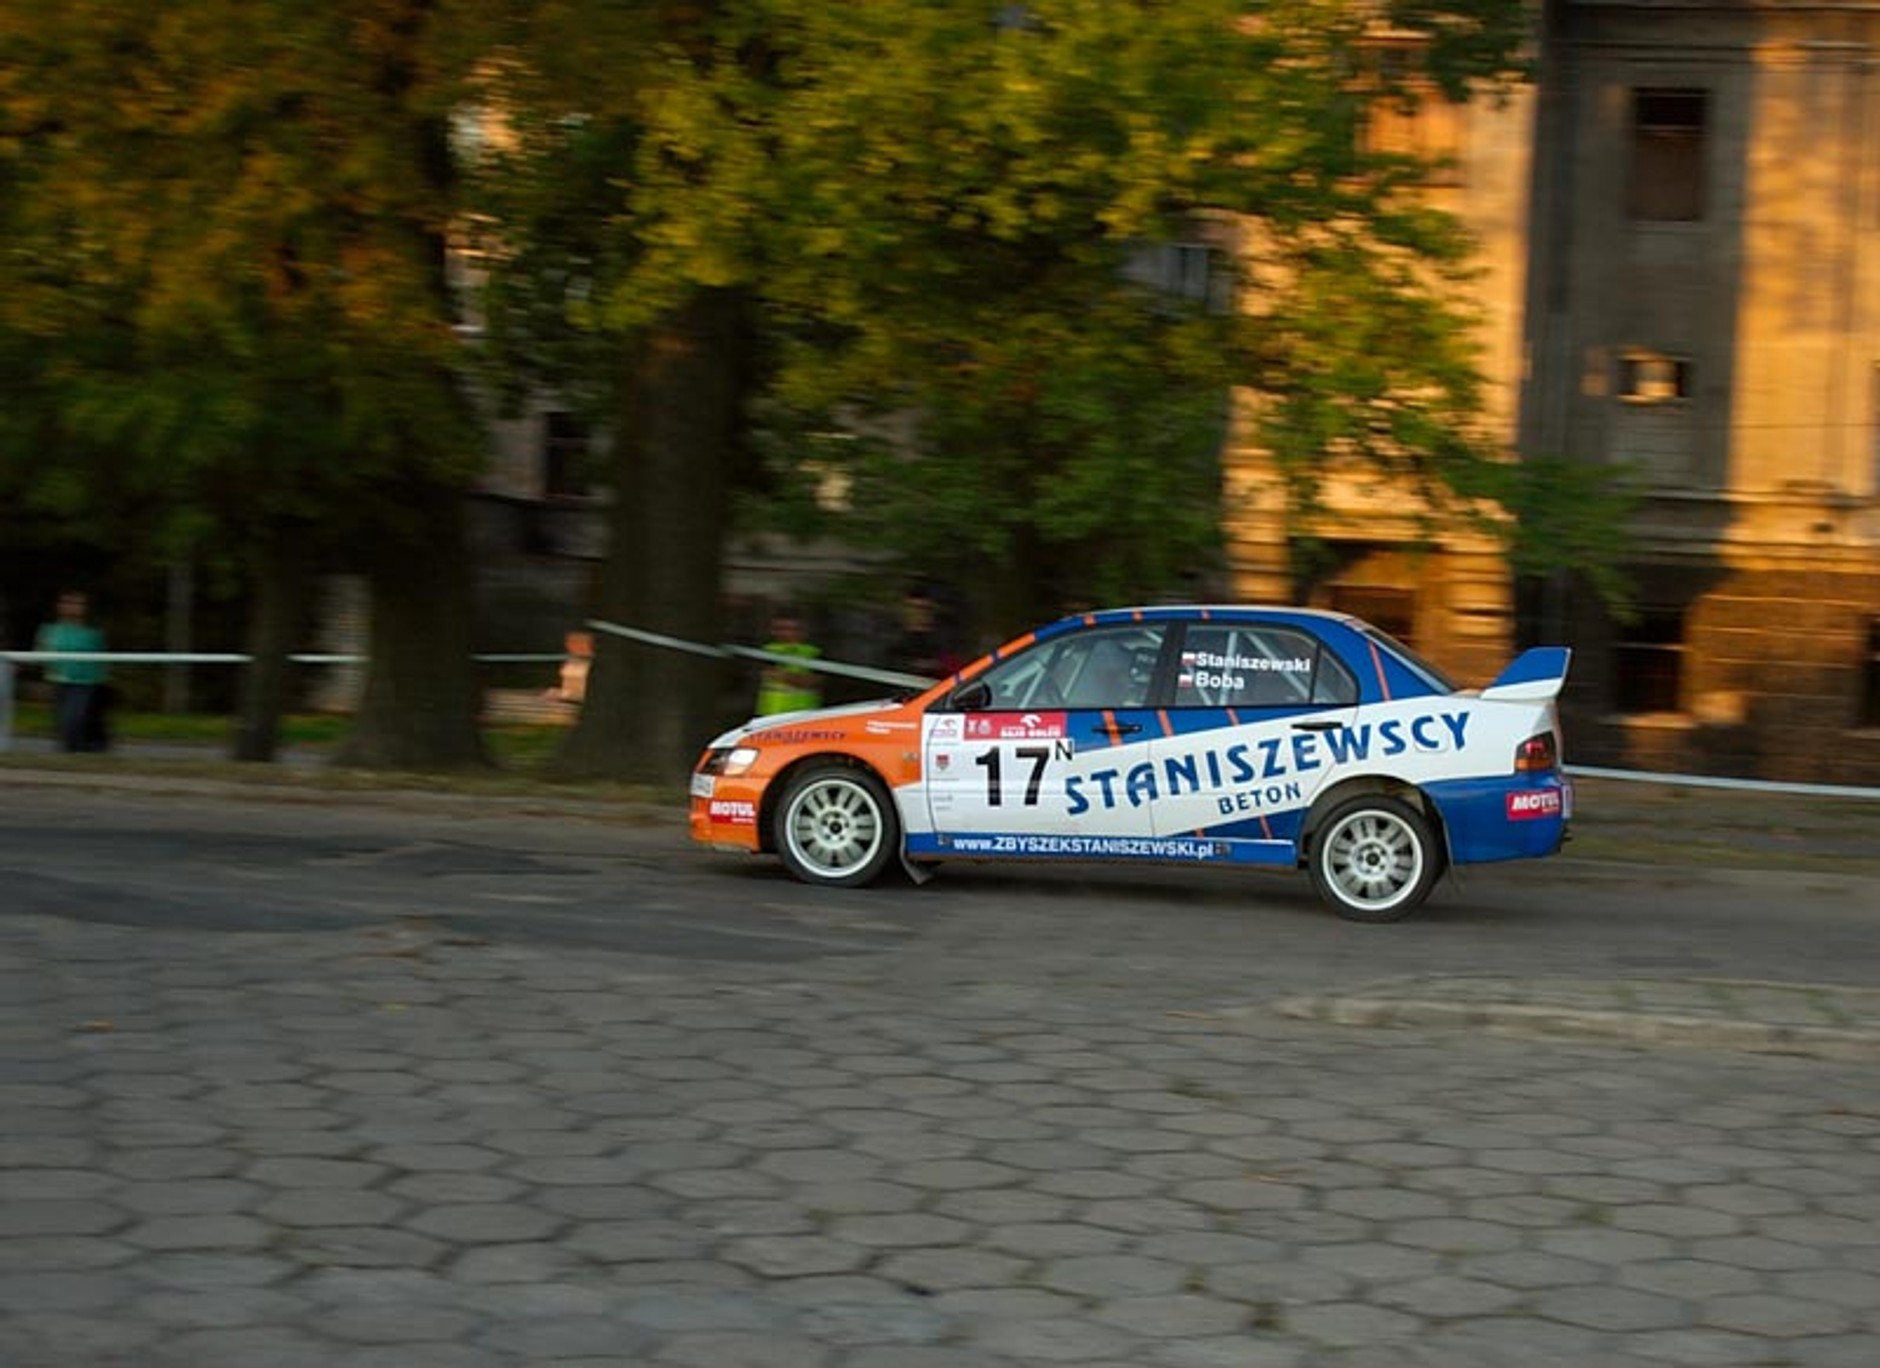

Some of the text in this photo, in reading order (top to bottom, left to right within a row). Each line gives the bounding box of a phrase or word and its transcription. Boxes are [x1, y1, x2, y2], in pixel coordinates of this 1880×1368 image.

[1196, 652, 1311, 672] Staniszewski
[1195, 671, 1245, 690] Boba
[975, 740, 1074, 807] 17 N
[1064, 711, 1470, 816] STANISZEWSCY
[710, 801, 756, 817] MOTUL
[1217, 782, 1302, 815] BETON
[953, 836, 1214, 859] www.ZBYSZEKSTANISZEWSKI.pl
